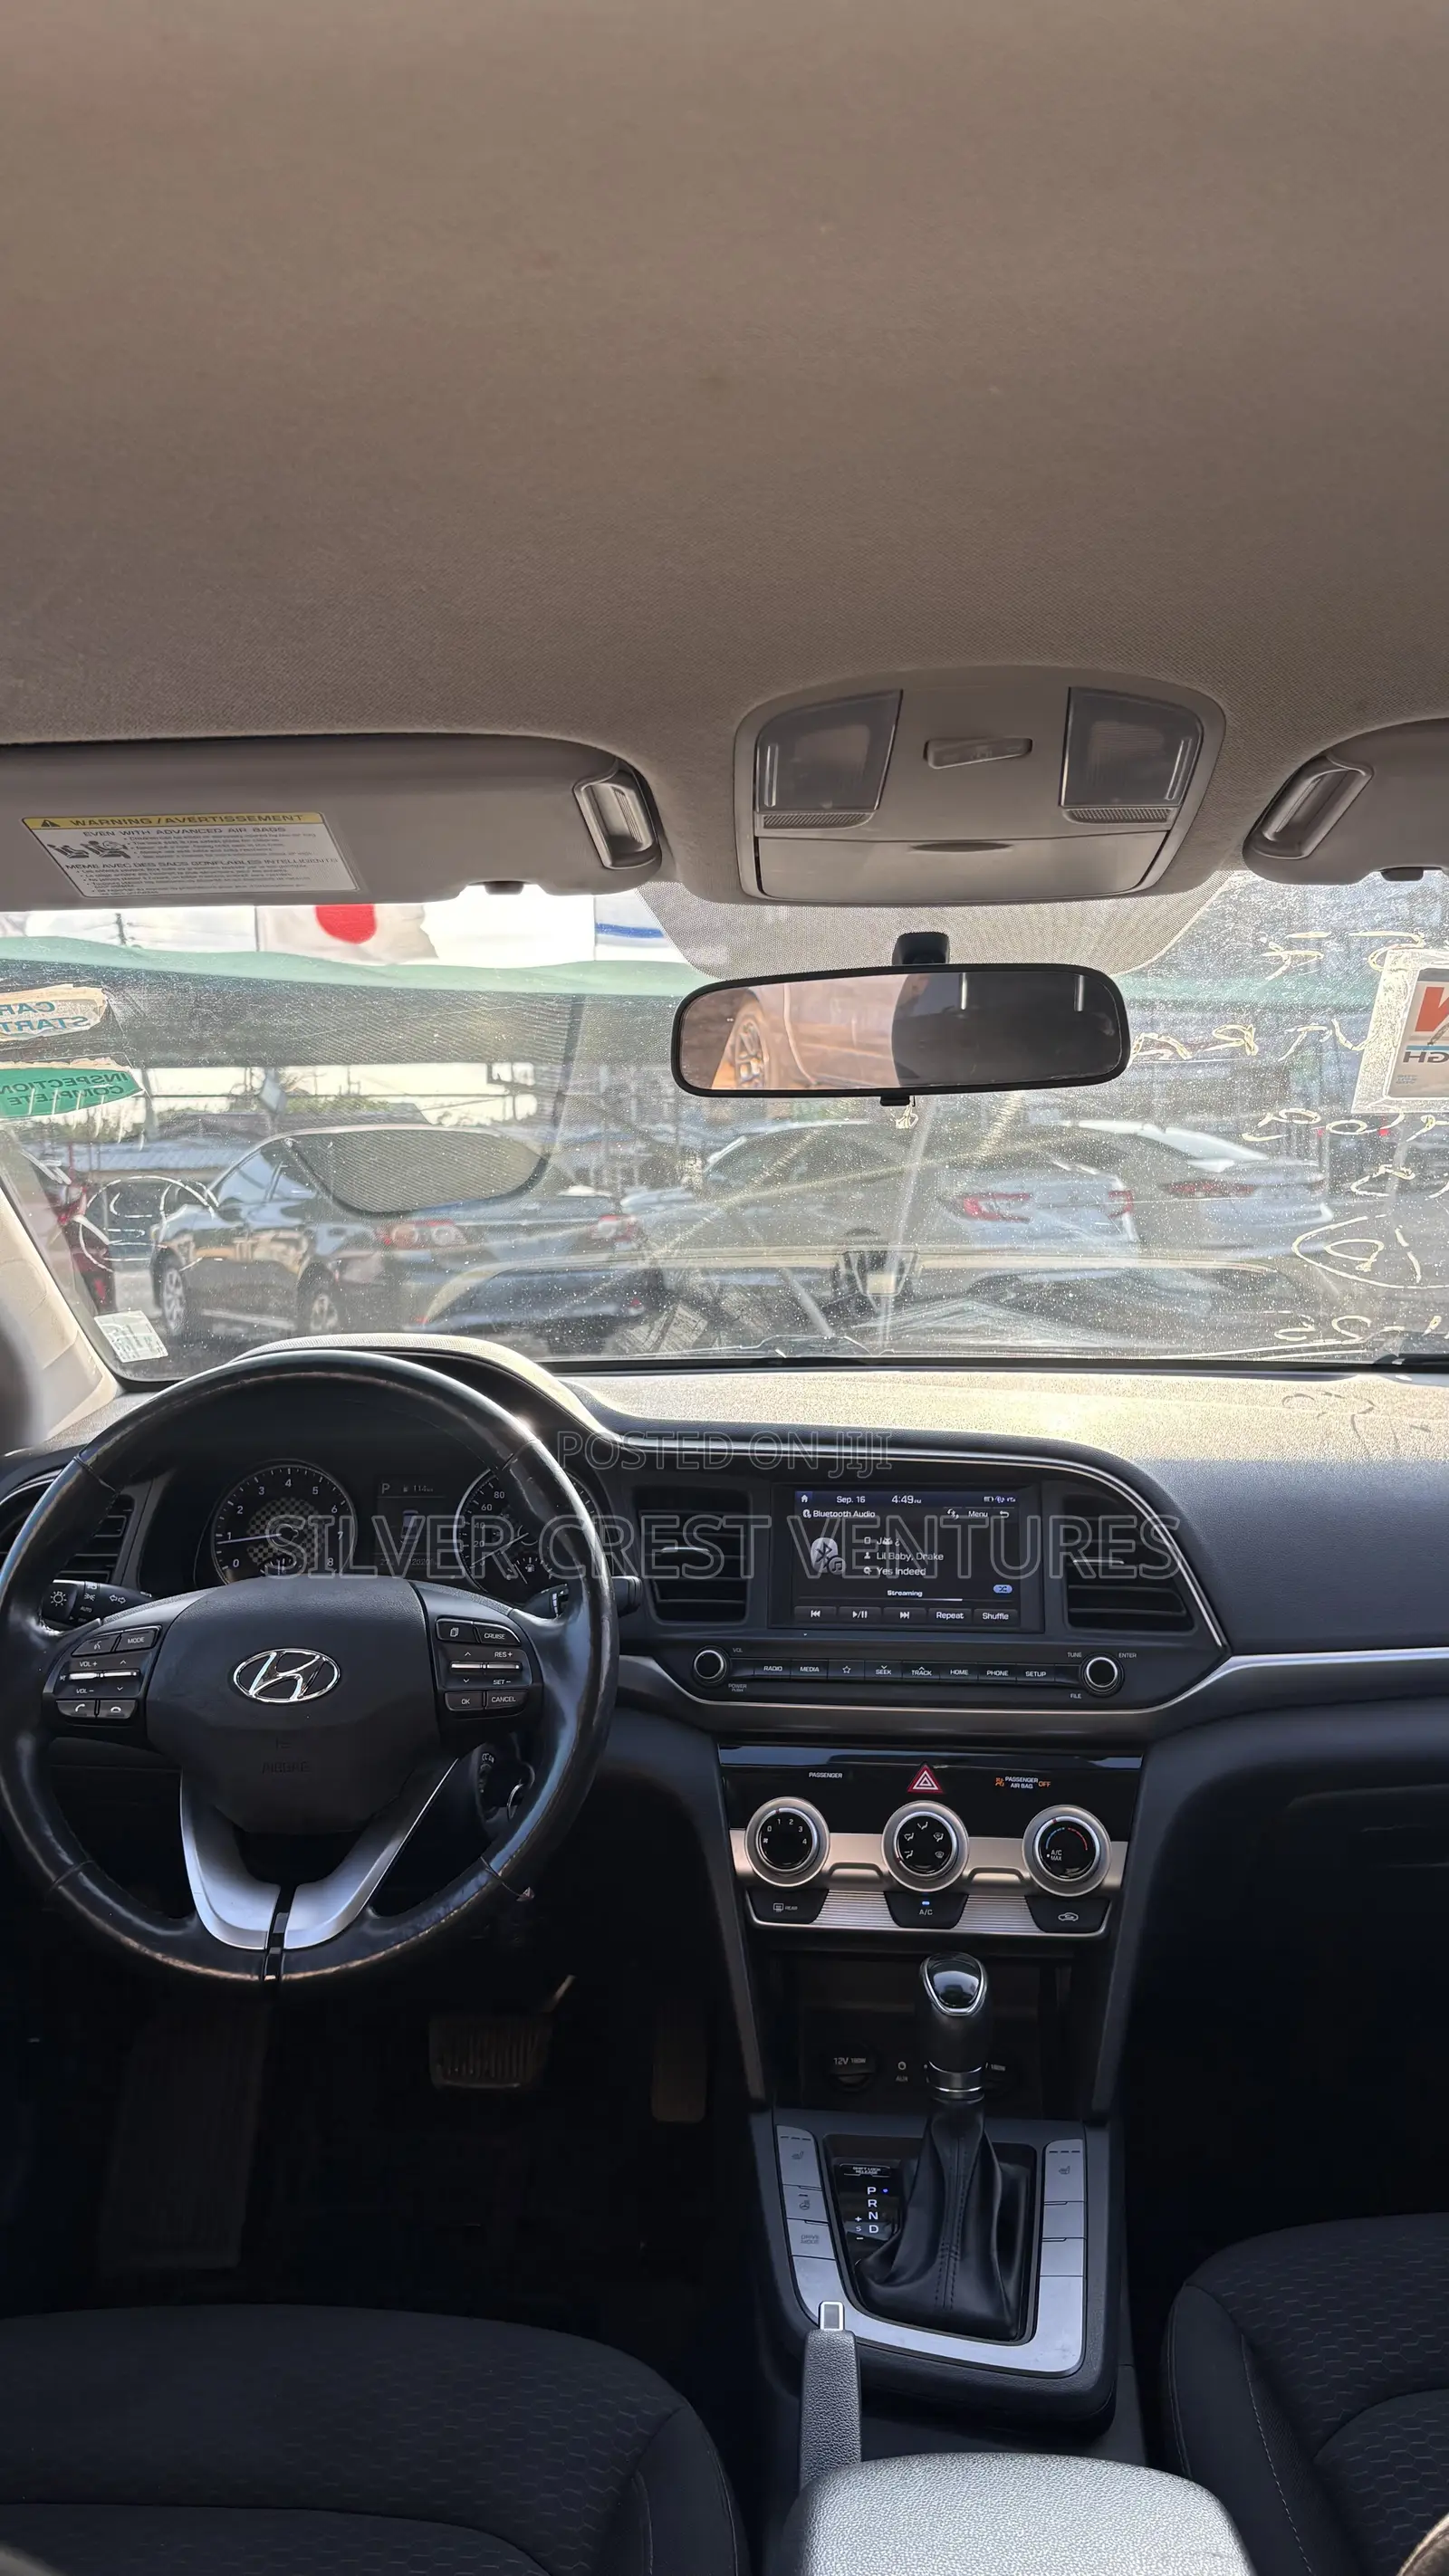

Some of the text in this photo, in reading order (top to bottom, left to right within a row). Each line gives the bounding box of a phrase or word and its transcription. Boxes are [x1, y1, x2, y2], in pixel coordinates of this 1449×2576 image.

[71, 817, 152, 827] WARNING
[164, 815, 305, 825] AVERTISSEMENT
[284, 1479, 292, 1488] 4
[258, 1486, 264, 1495] 3
[312, 1487, 319, 1495] 5
[380, 1483, 390, 1494] P
[494, 1490, 505, 1499] 80
[836, 1496, 854, 1504] Sep.
[236, 1506, 244, 1515] 2
[331, 1505, 338, 1513] 6
[481, 1503, 493, 1511] 60
[812, 1509, 876, 1518] Bluetooth Audio
[337, 1531, 343, 1539] 7
[876, 1552, 944, 1562] Lil Baby, Drake
[233, 1559, 240, 1567] 0
[327, 1558, 334, 1566] 8
[876, 1567, 926, 1575] Yes Indeed
[887, 1590, 922, 1598] Streaming
[936, 1612, 964, 1621] Repeat
[127, 1636, 145, 1644] MODE
[918, 1908, 933, 1917] A/C
[833, 2057, 849, 2066] 12V
[867, 2186, 877, 2195] P
[868, 2198, 878, 2207] R
[868, 2211, 878, 2220] N
[868, 2224, 879, 2234] D
